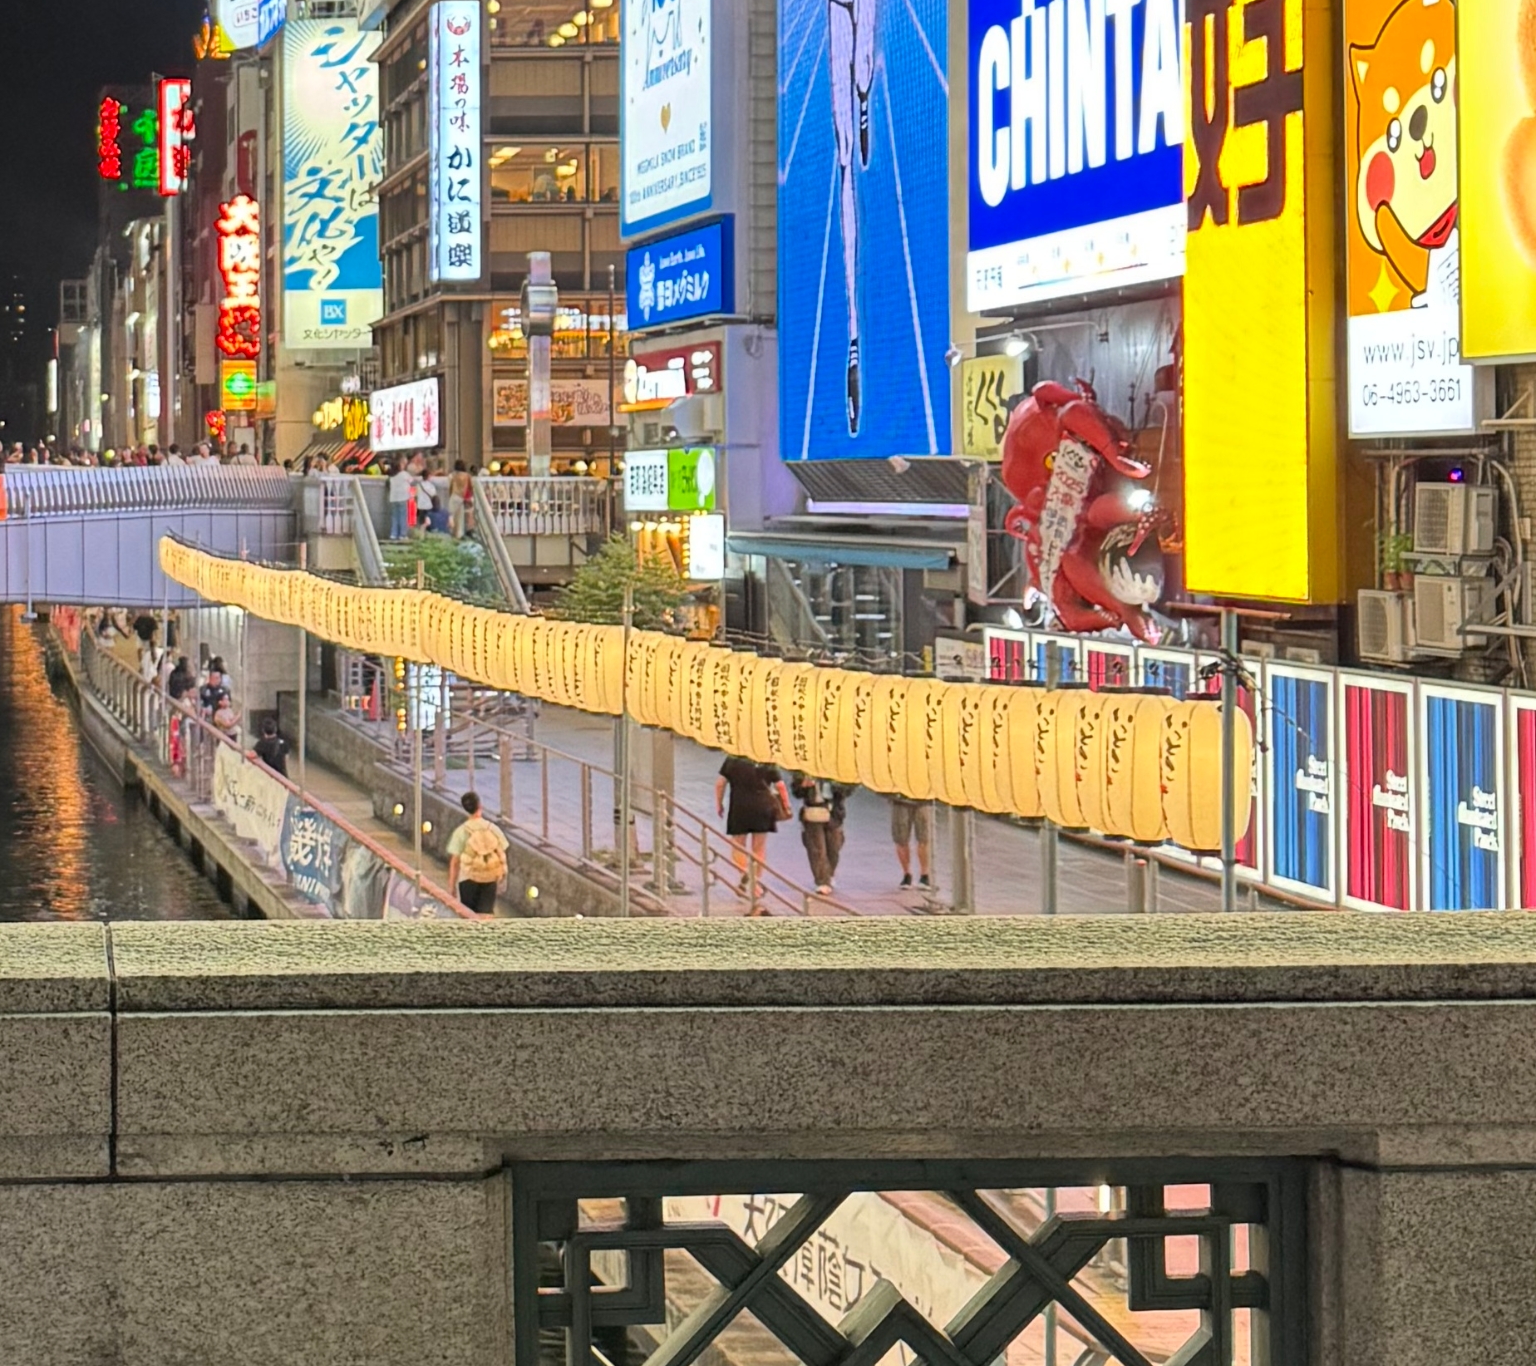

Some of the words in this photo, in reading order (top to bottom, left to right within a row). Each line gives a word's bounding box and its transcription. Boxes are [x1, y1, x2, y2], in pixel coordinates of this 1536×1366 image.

[324, 304, 344, 318] BX
[1364, 331, 1460, 369] www.jsv.jp
[1362, 378, 1462, 407] 06-4963-3661
